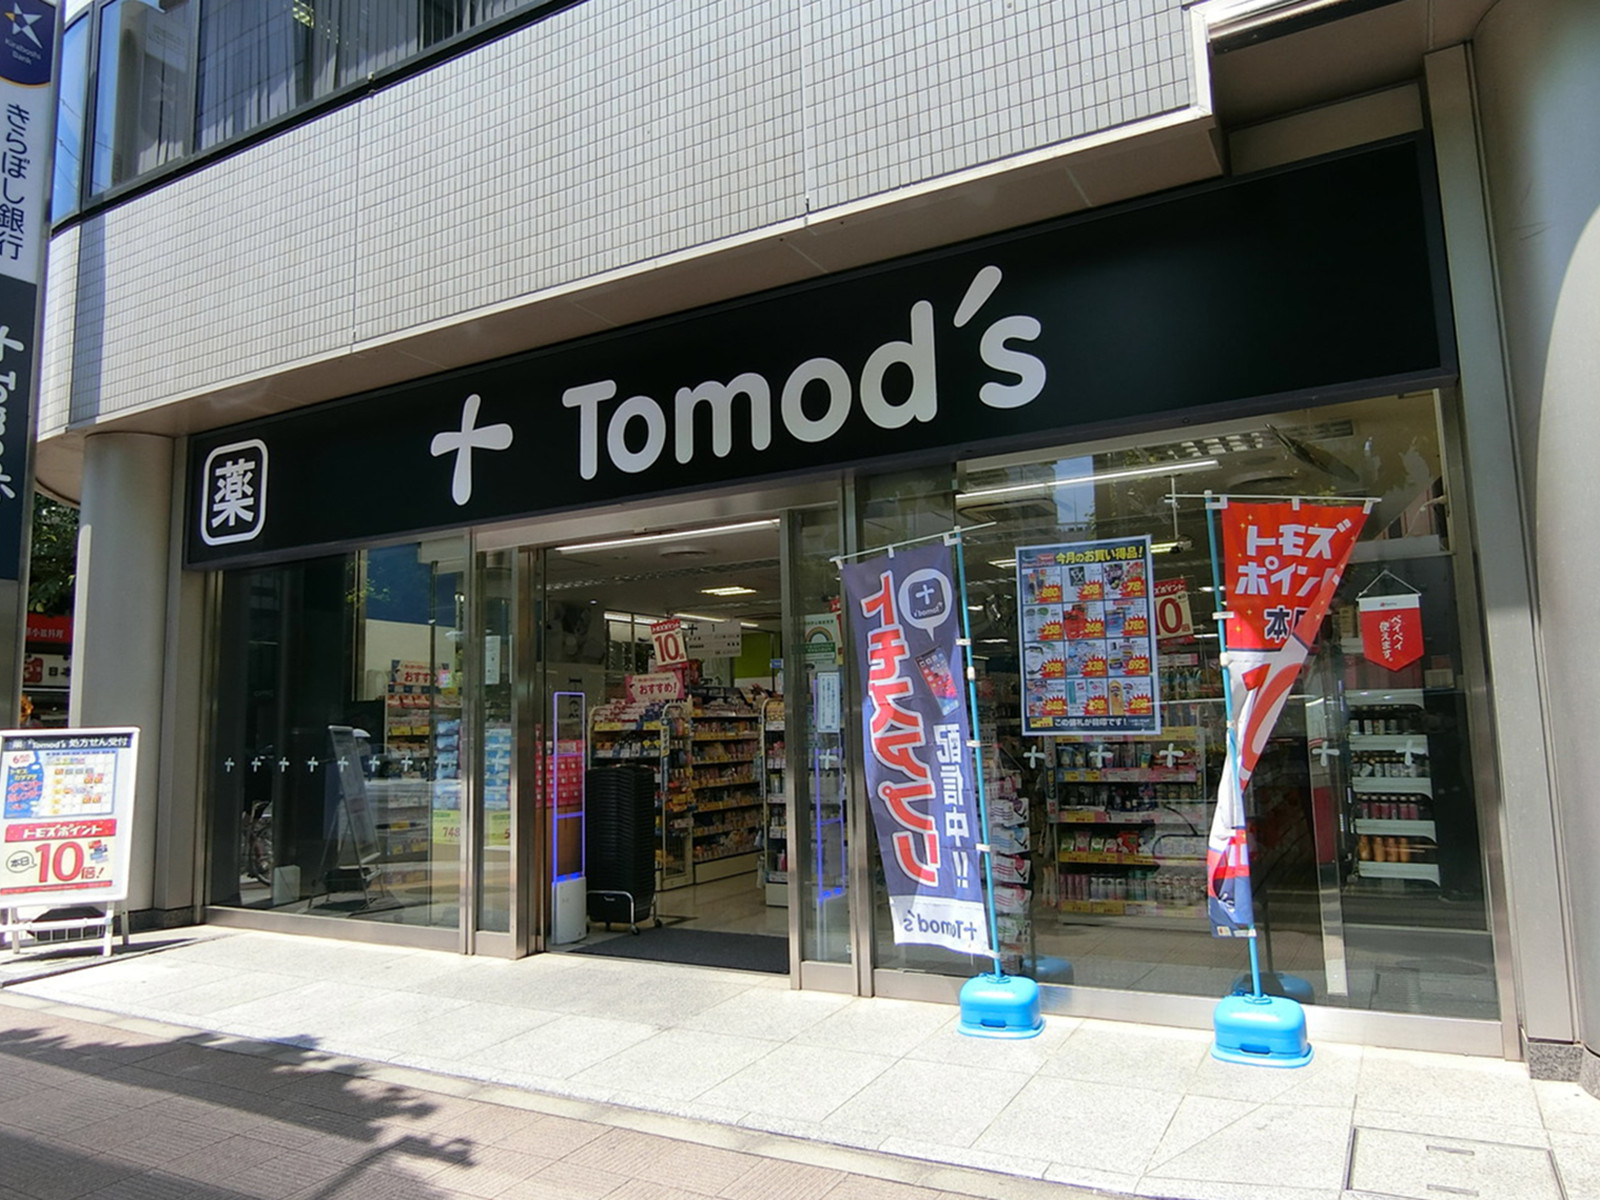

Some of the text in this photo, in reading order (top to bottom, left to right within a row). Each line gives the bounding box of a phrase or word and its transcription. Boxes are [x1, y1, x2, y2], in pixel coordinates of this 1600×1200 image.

[0, 103, 30, 260] きらぼし銀行
[562, 265, 1047, 480] Tomod's
[213, 460, 255, 530] 薬
[1246, 518, 1352, 559] トモズ
[639, 683, 678, 695] おすすめ!
[23, 824, 103, 839] トモズポイント
